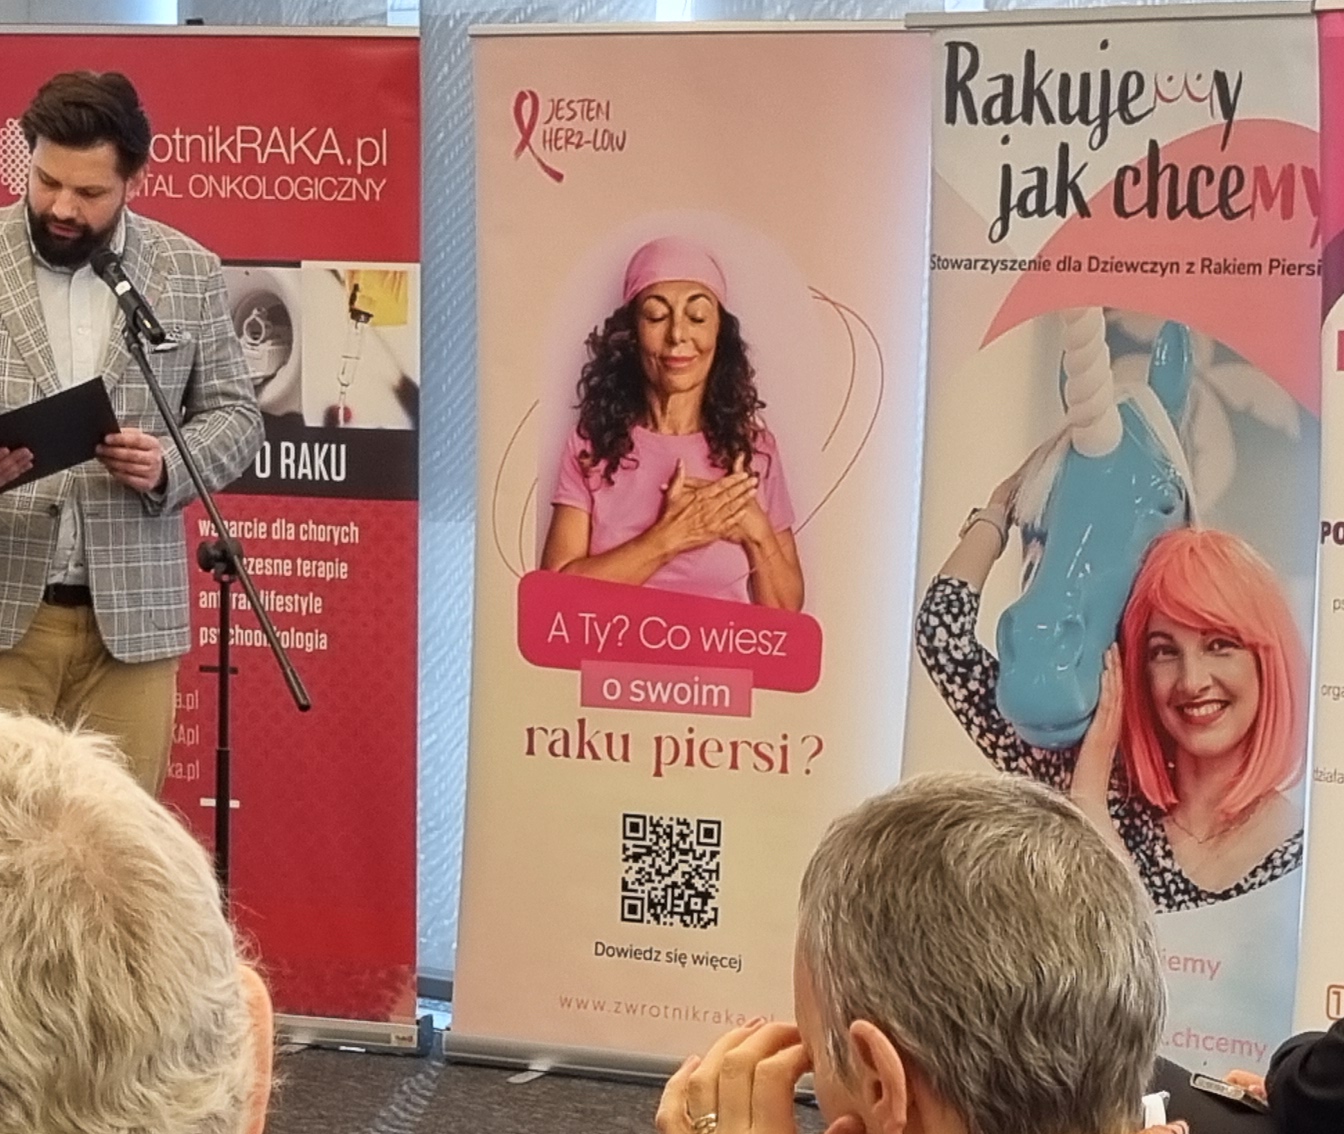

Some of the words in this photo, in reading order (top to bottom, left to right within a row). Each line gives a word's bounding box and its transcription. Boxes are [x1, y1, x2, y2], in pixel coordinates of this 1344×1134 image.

[149, 125, 388, 174] otnikRAKA.pl
[188, 174, 387, 202] ONKOLOGICZNY
[988, 134, 1093, 244] jak
[930, 253, 1052, 276] Stowarzyszenie
[1056, 255, 1083, 273] dla
[1087, 256, 1180, 278] Dziewczyn
[1185, 262, 1196, 275] z
[1200, 257, 1263, 276] Rakiem
[1268, 258, 1323, 277] Piersi
[280, 441, 347, 482] RAKU
[271, 518, 296, 541] dla
[299, 519, 360, 546] chorych
[296, 557, 349, 582] terapie
[259, 589, 323, 616] lifestyle
[547, 611, 570, 644] A
[577, 612, 630, 652] Ty?
[638, 616, 692, 651] Co
[699, 621, 788, 657] wiesz
[602, 677, 622, 700] o
[629, 676, 731, 708] swoim
[524, 717, 633, 763] raku
[593, 941, 662, 963] Dowiedz
[664, 948, 687, 968] się
[691, 951, 743, 974] więcej
